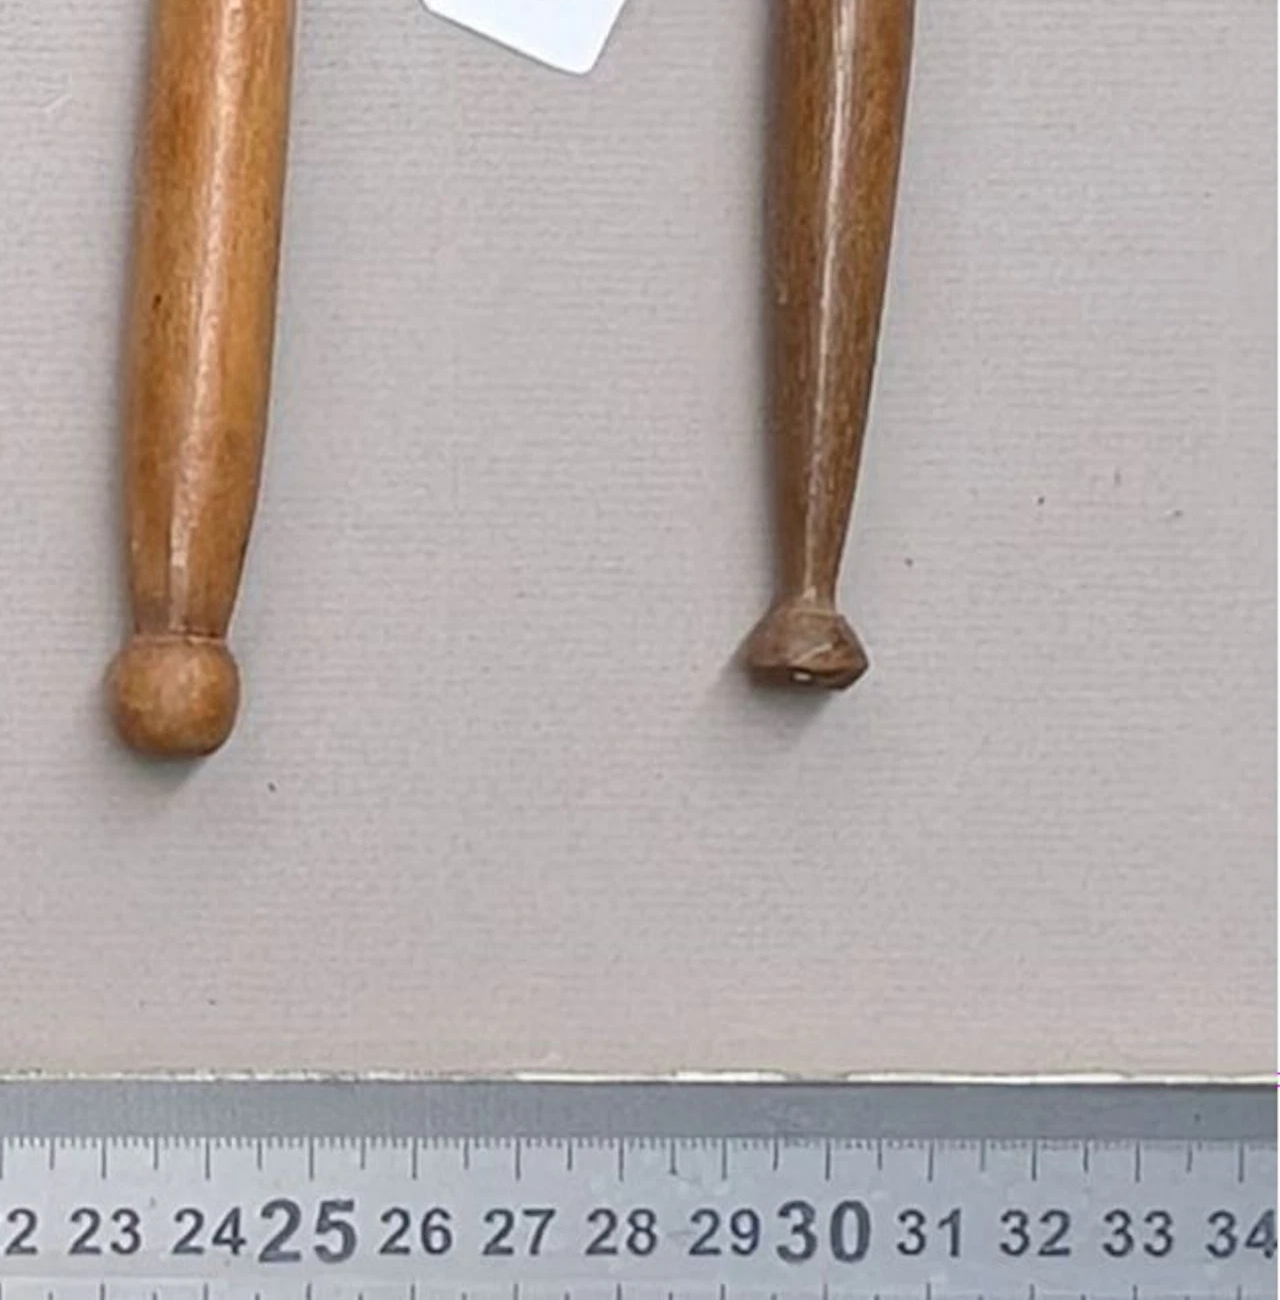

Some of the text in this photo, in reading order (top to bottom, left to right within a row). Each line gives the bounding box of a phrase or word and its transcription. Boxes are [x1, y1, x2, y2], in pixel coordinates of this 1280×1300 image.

[68, 1207, 141, 1256] 23
[171, 1207, 247, 1257] 24
[258, 1198, 357, 1264] 25
[379, 1207, 452, 1256] 26
[482, 1208, 556, 1256] 27
[585, 1208, 658, 1257] 28
[688, 1208, 760, 1257] 29
[776, 1200, 871, 1264] 30
[897, 1208, 961, 1258] 31
[999, 1209, 1072, 1257] 32
[1102, 1209, 1174, 1258] 33
[1205, 1209, 1278, 1260] 34
